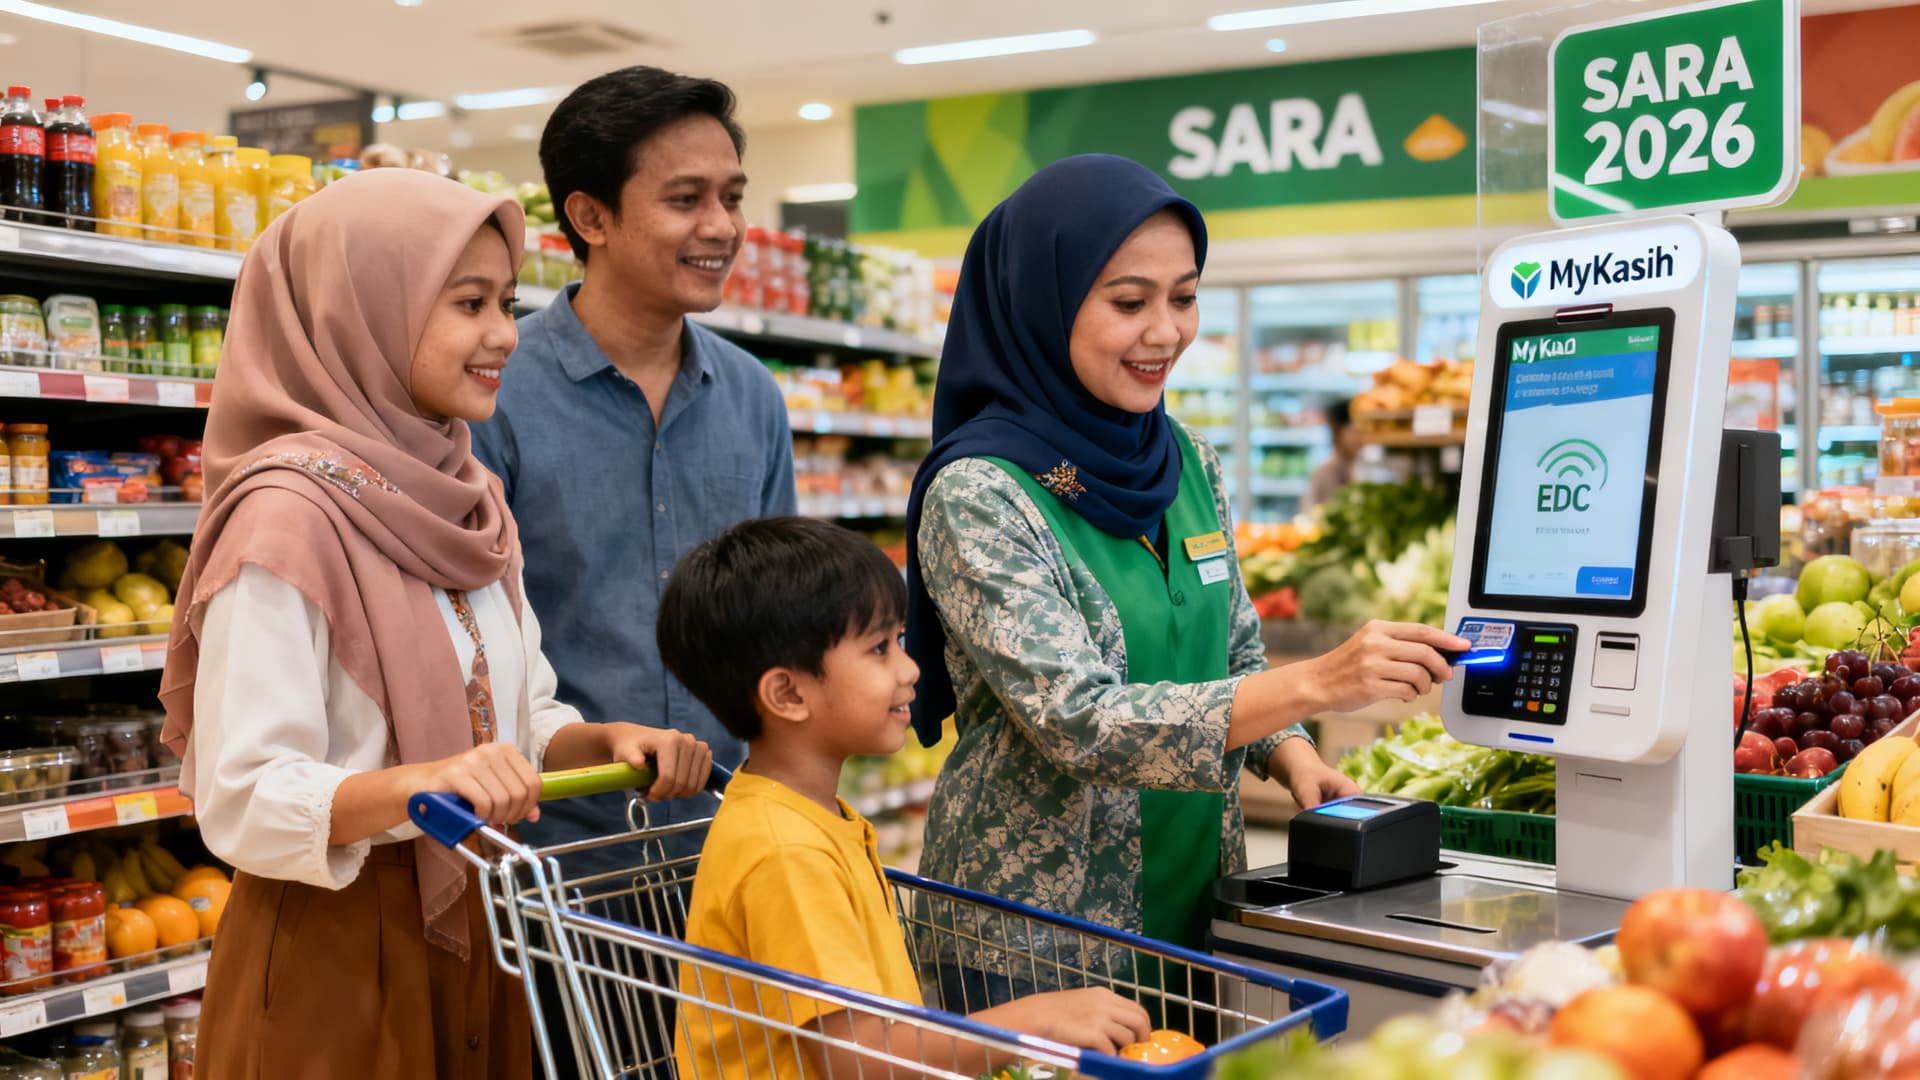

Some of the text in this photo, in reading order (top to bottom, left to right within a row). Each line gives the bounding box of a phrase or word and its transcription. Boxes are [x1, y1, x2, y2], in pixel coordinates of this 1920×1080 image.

[1582, 36, 1754, 113] SARA
[1168, 93, 1383, 179] SARA
[1584, 102, 1755, 185] 2026
[1550, 245, 1674, 295] MyKasih
[1537, 483, 1591, 513] EDC
